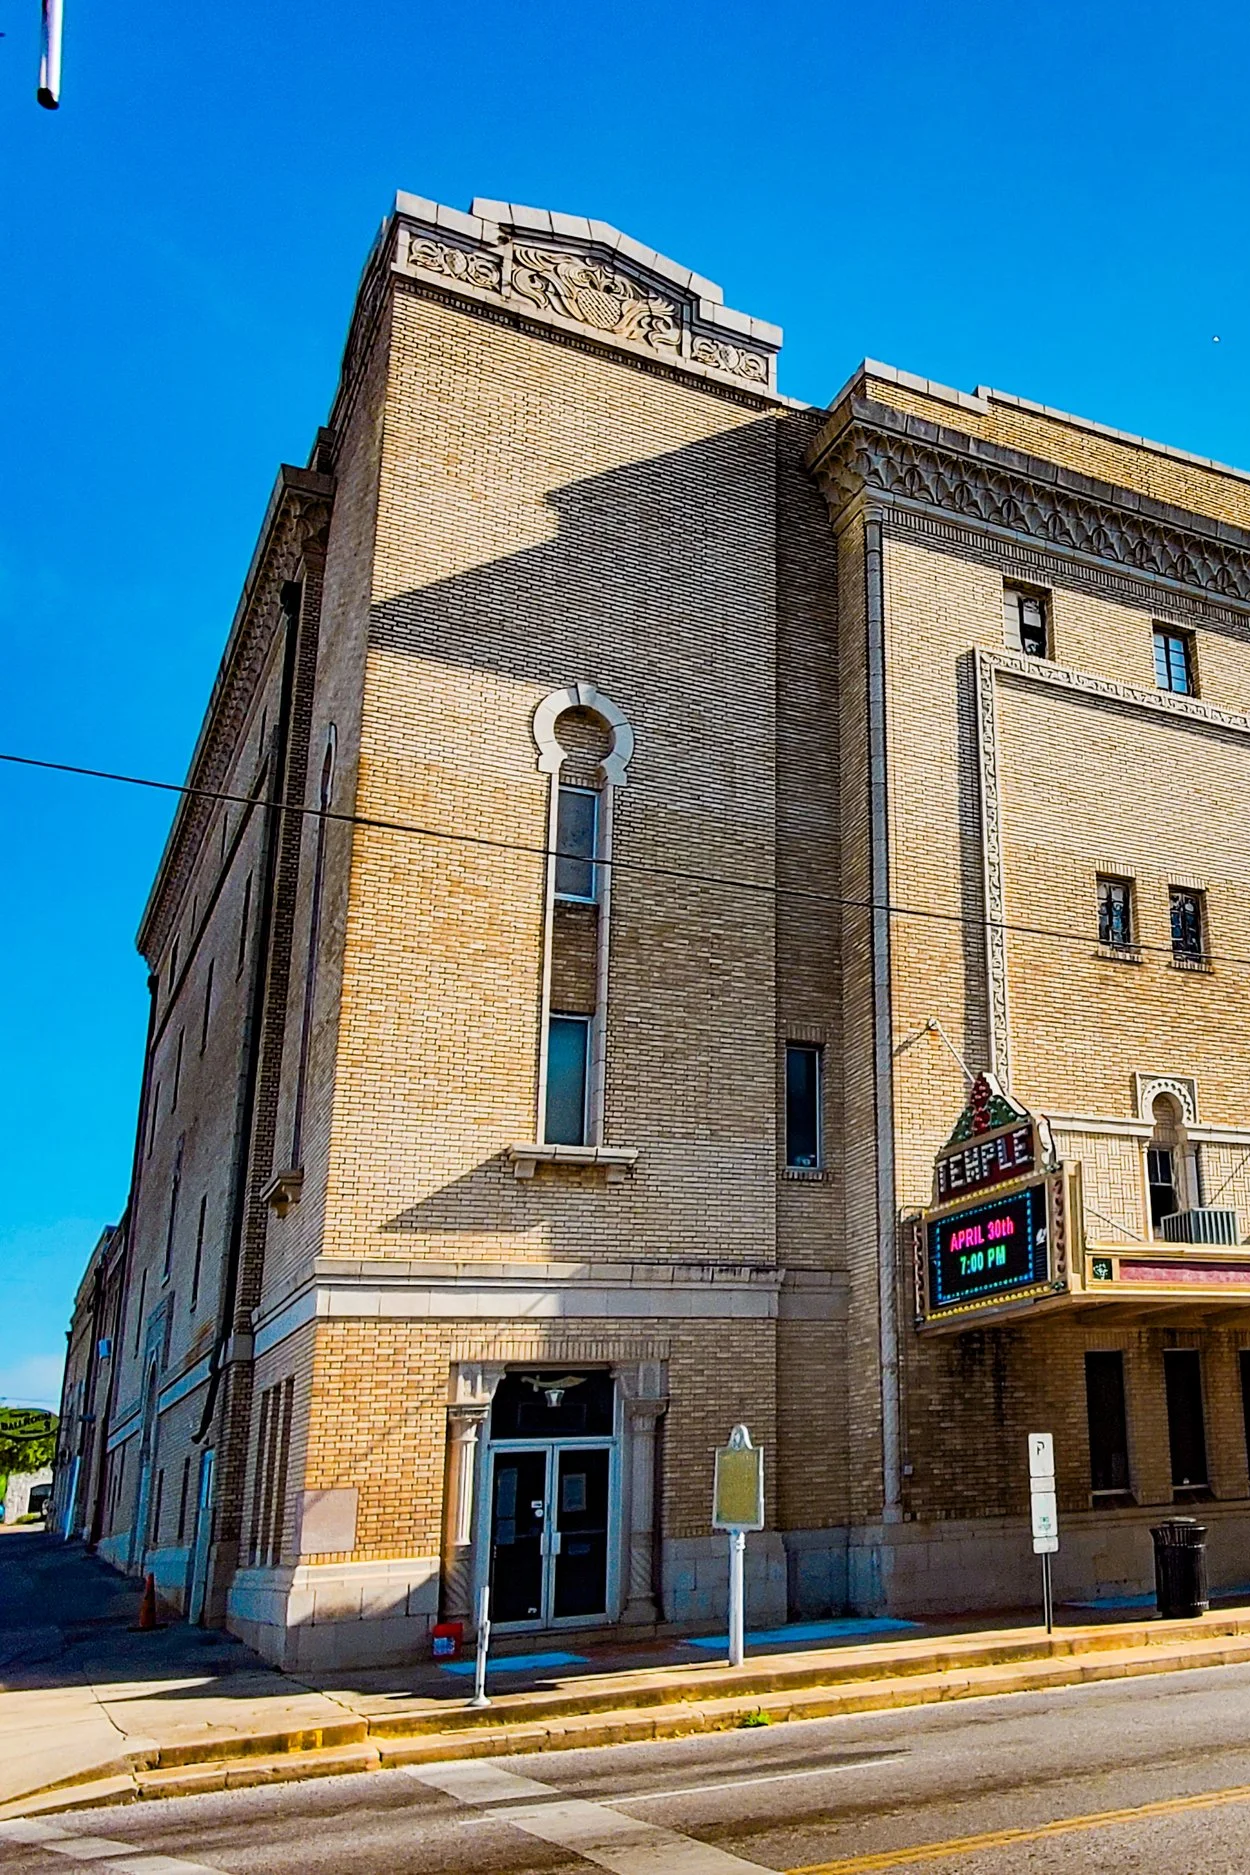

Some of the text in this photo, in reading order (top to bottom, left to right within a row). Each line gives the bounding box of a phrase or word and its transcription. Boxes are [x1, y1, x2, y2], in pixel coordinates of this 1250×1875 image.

[937, 1128, 1029, 1193] TEMPLE
[950, 1216, 1015, 1253] APRIL 30th
[960, 1244, 1007, 1276] 7:00 PM
